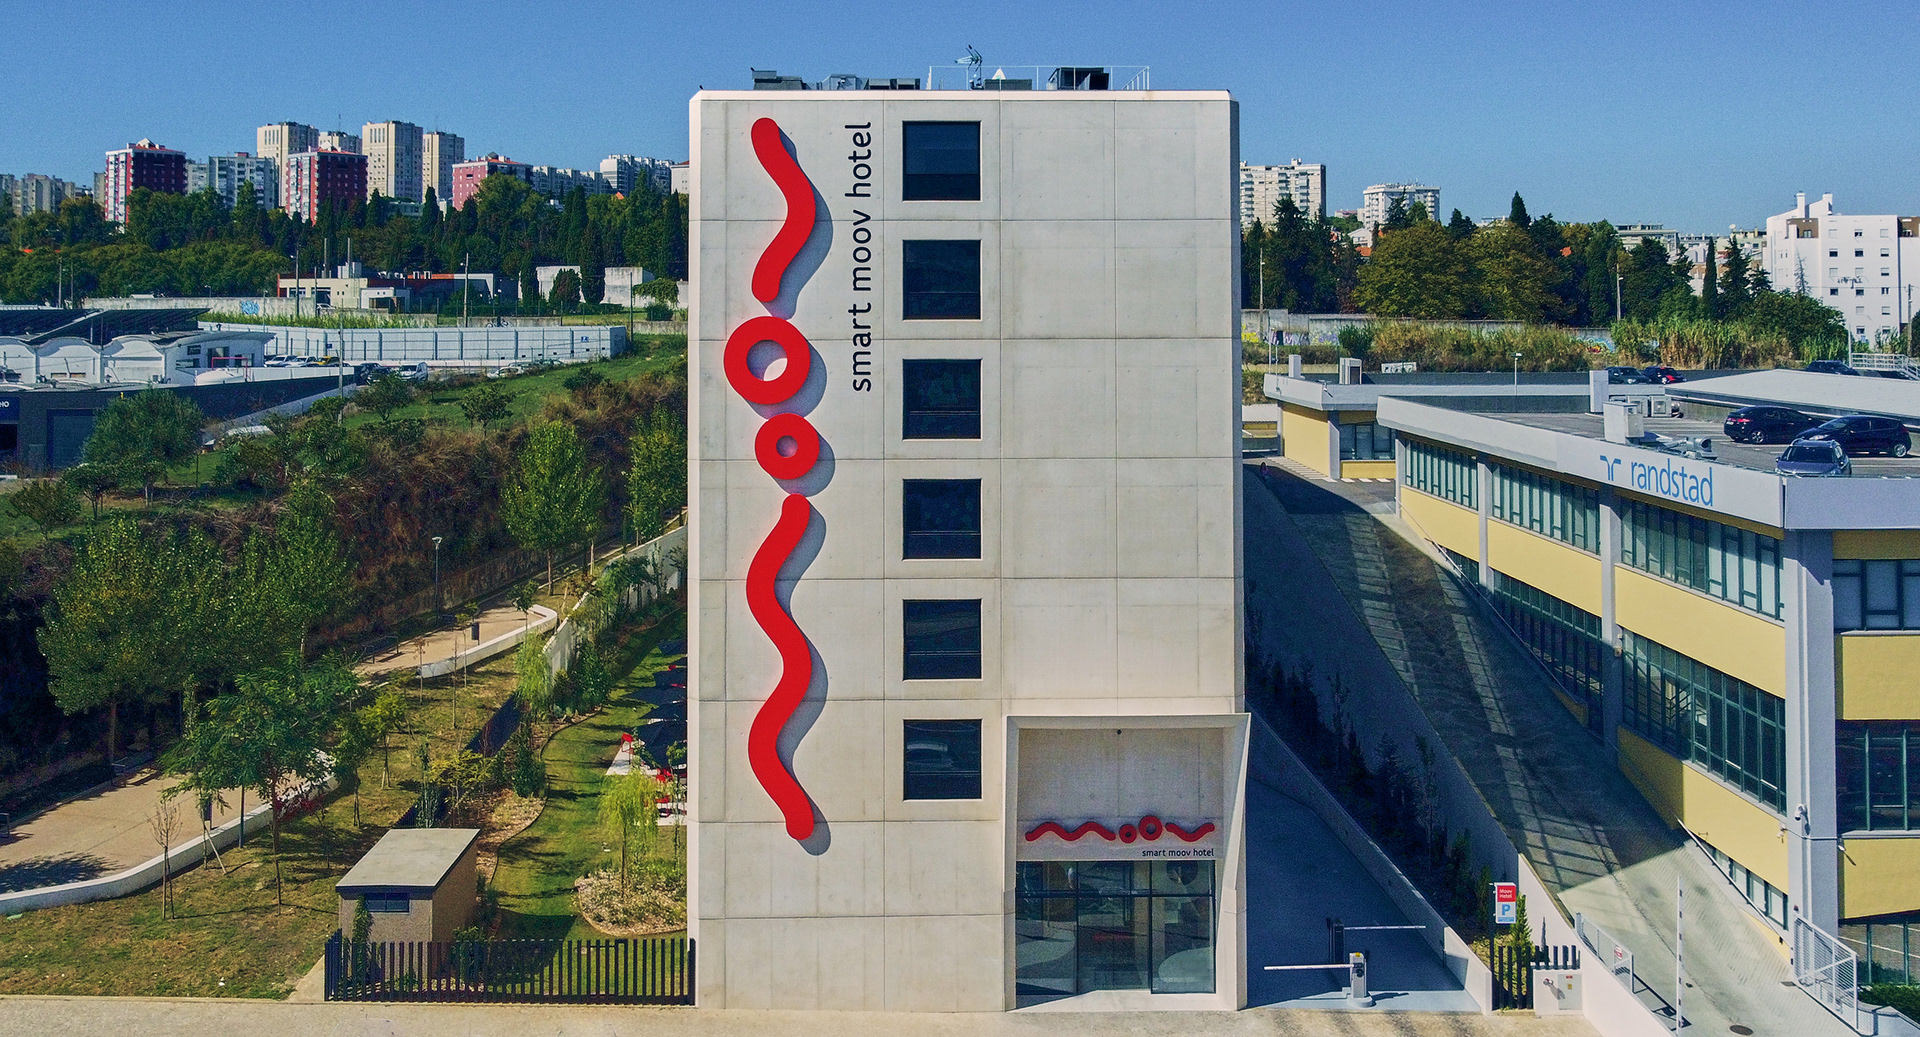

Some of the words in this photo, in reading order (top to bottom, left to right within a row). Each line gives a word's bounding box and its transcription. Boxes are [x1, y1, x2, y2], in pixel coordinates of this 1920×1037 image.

[844, 121, 872, 198] hotel
[852, 209, 872, 292] moov
[847, 302, 872, 392] smart
[1631, 458, 1713, 507] randstad
[1142, 849, 1166, 857] smart
[1193, 848, 1215, 857] hotel
[1501, 904, 1511, 916] P
